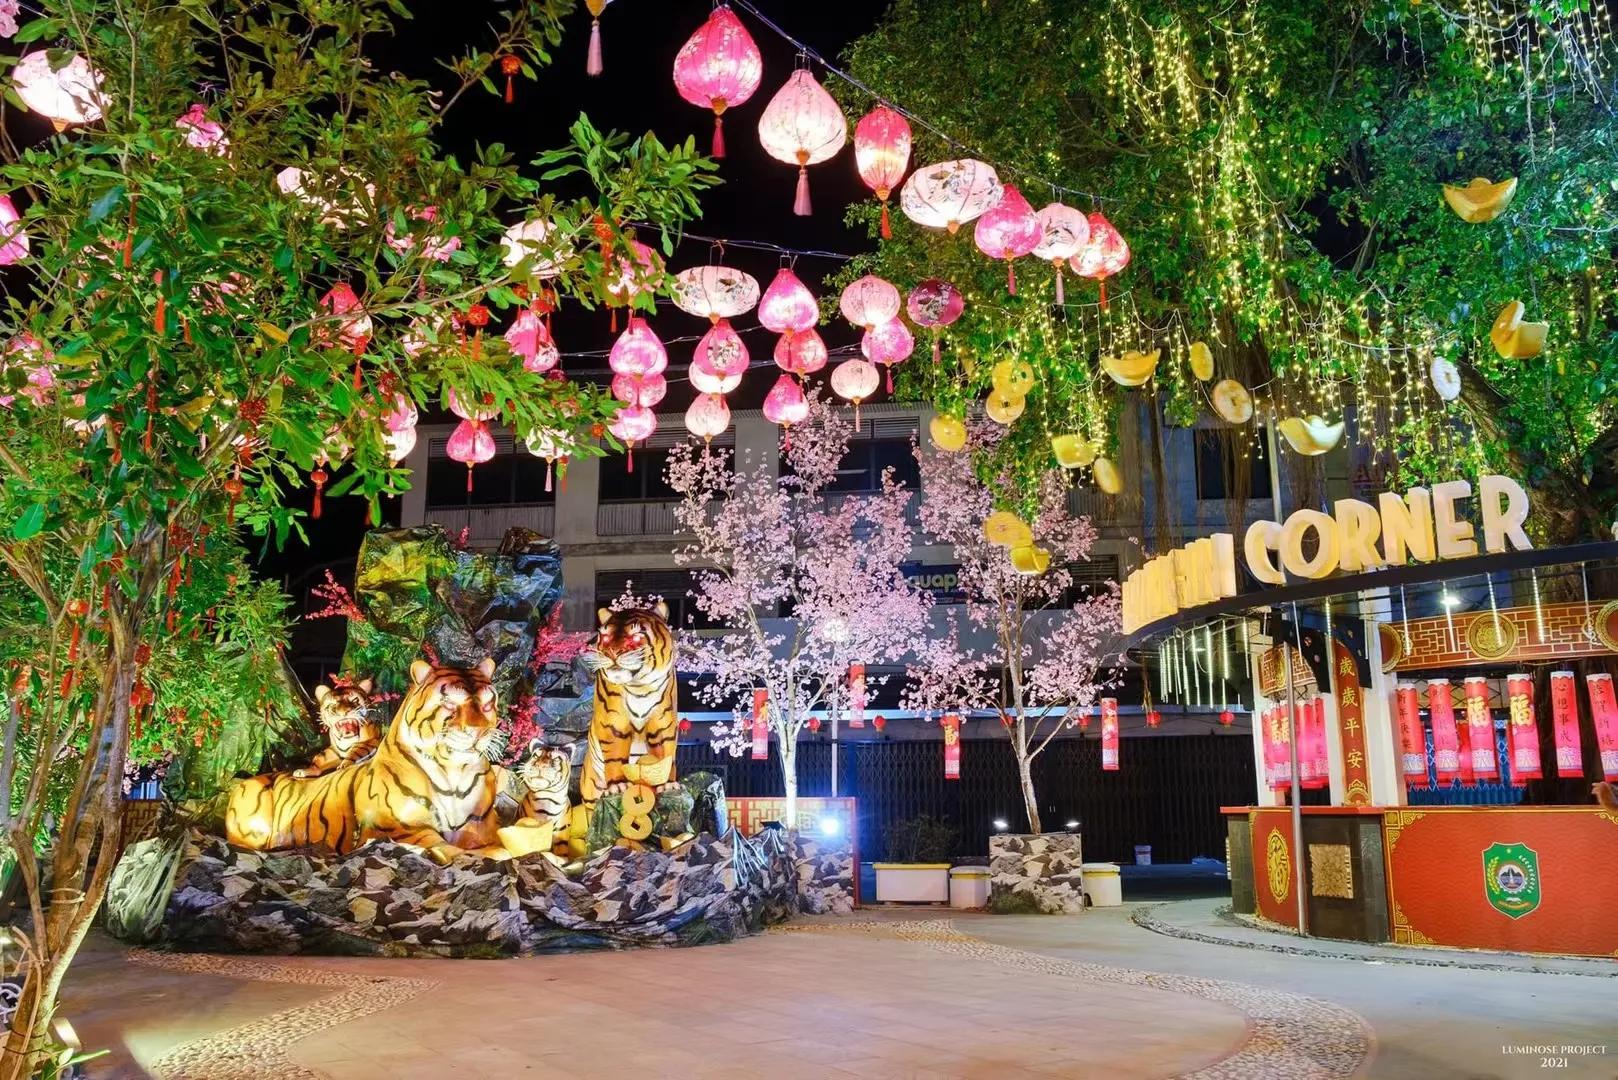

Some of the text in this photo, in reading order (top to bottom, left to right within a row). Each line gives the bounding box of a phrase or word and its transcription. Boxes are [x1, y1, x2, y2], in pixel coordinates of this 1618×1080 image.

[1244, 475, 1533, 584] CORNER
[1339, 656, 1363, 769] 歲歲平安
[1510, 693, 1532, 726] 福
